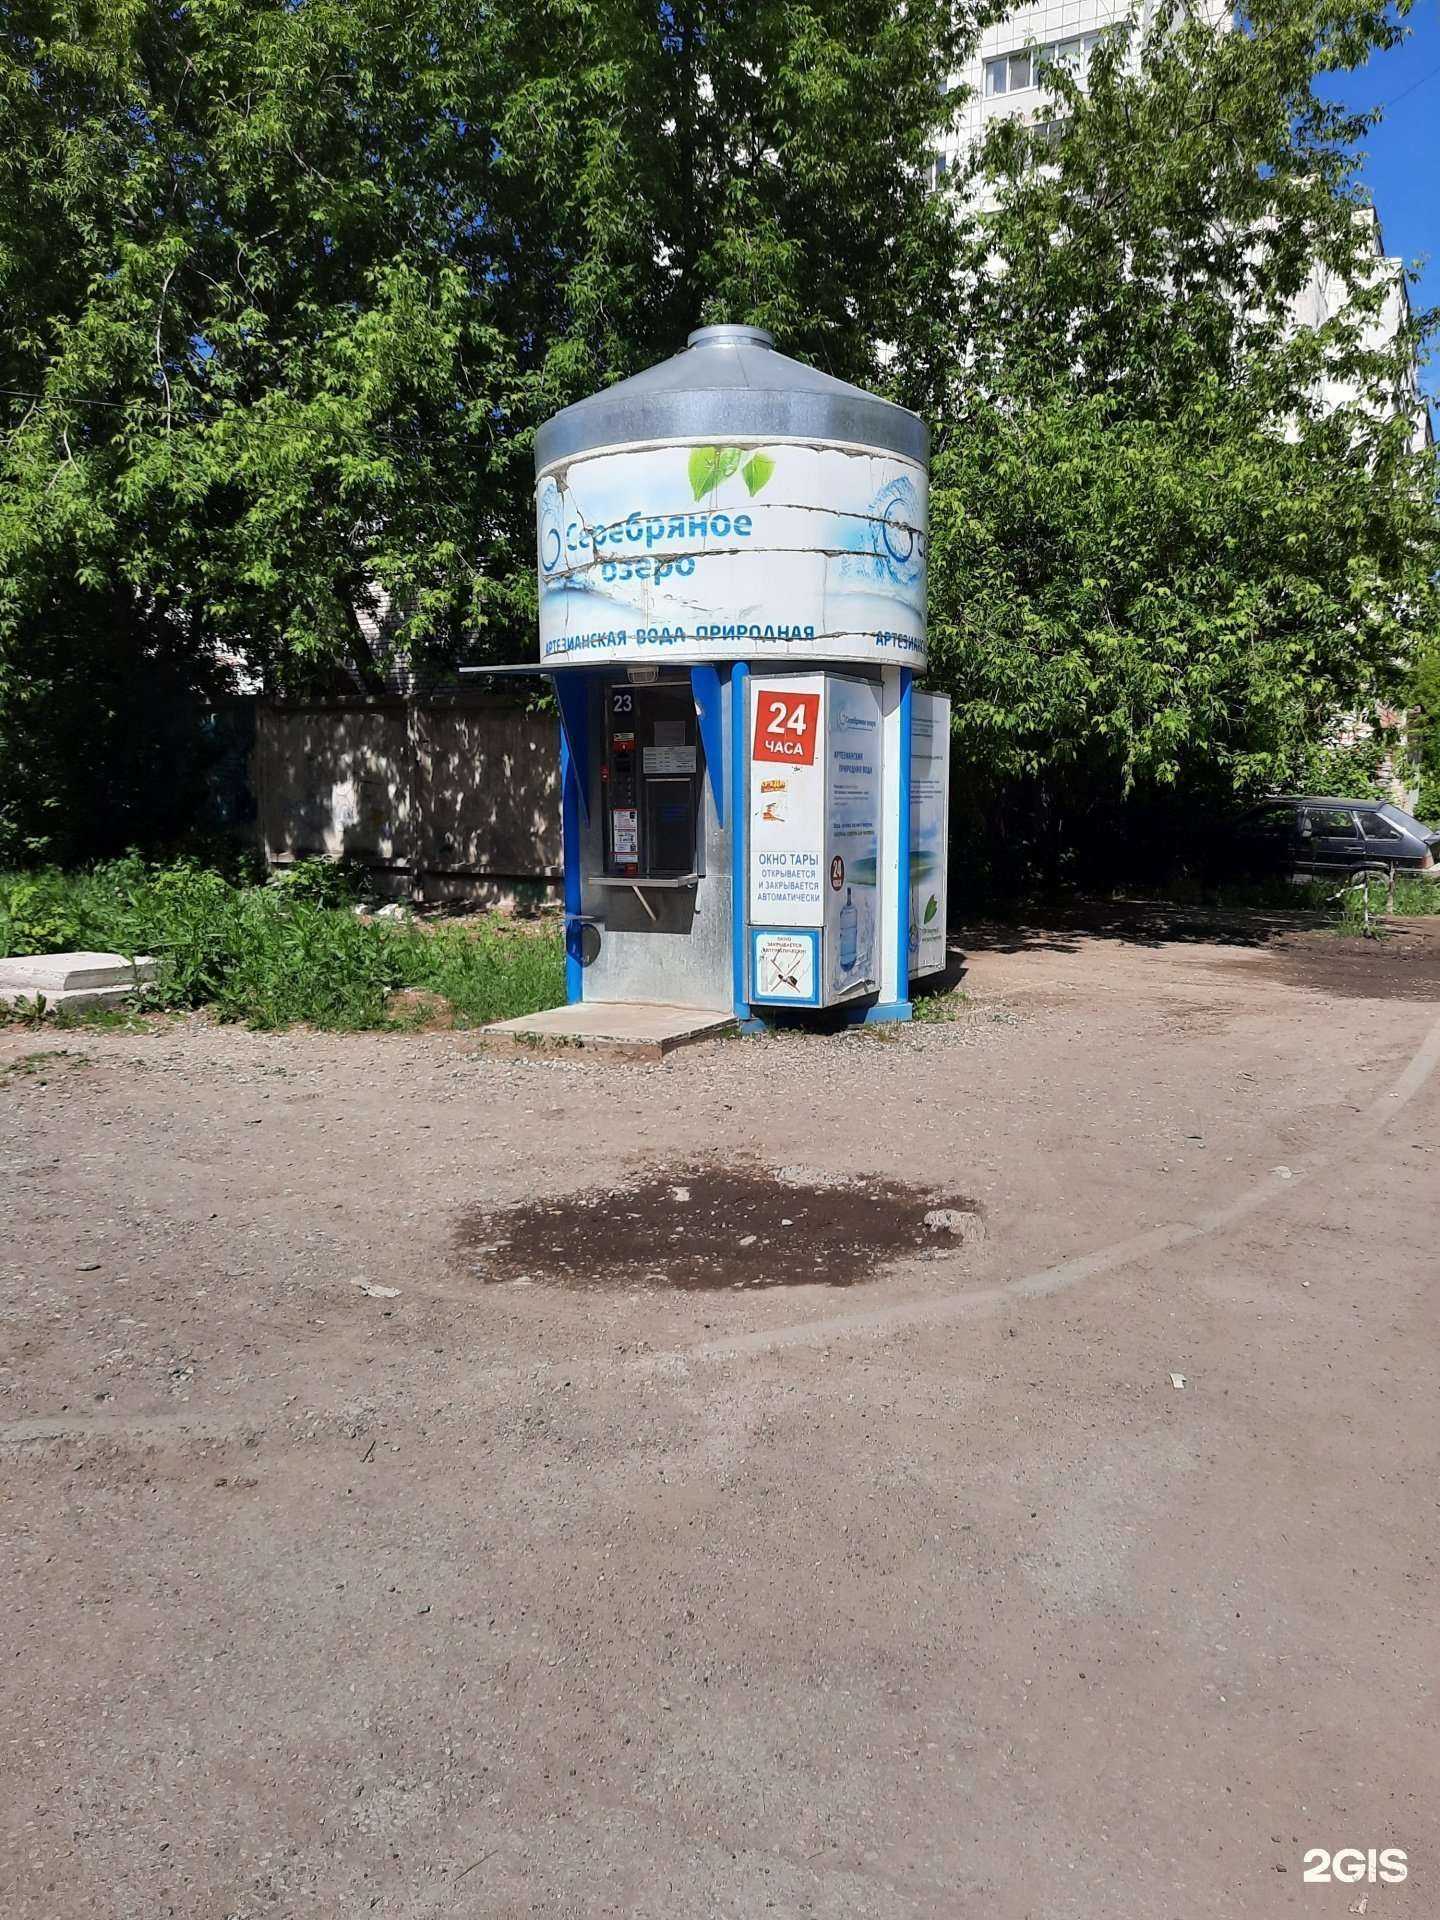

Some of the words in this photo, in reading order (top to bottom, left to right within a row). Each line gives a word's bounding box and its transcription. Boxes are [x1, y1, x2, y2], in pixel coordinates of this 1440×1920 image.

[545, 630, 627, 654] АРТЕЗИАНСКАЯ
[636, 626, 687, 646] ВОДА
[695, 624, 815, 643] ПРИРОДНАЯ
[613, 694, 633, 712] 23
[766, 701, 808, 737] 24
[764, 739, 805, 757] ЧАСА
[759, 853, 787, 866] ОКНО
[789, 853, 819, 866] ТАРЫ
[761, 869, 817, 879] ОТКРЫВАЕТСЯ
[758, 881, 764, 890] И
[765, 881, 820, 891] ЗАКРЫВАЕТСЯ
[757, 892, 821, 903] АВТОМАТИЧЕСКИ
